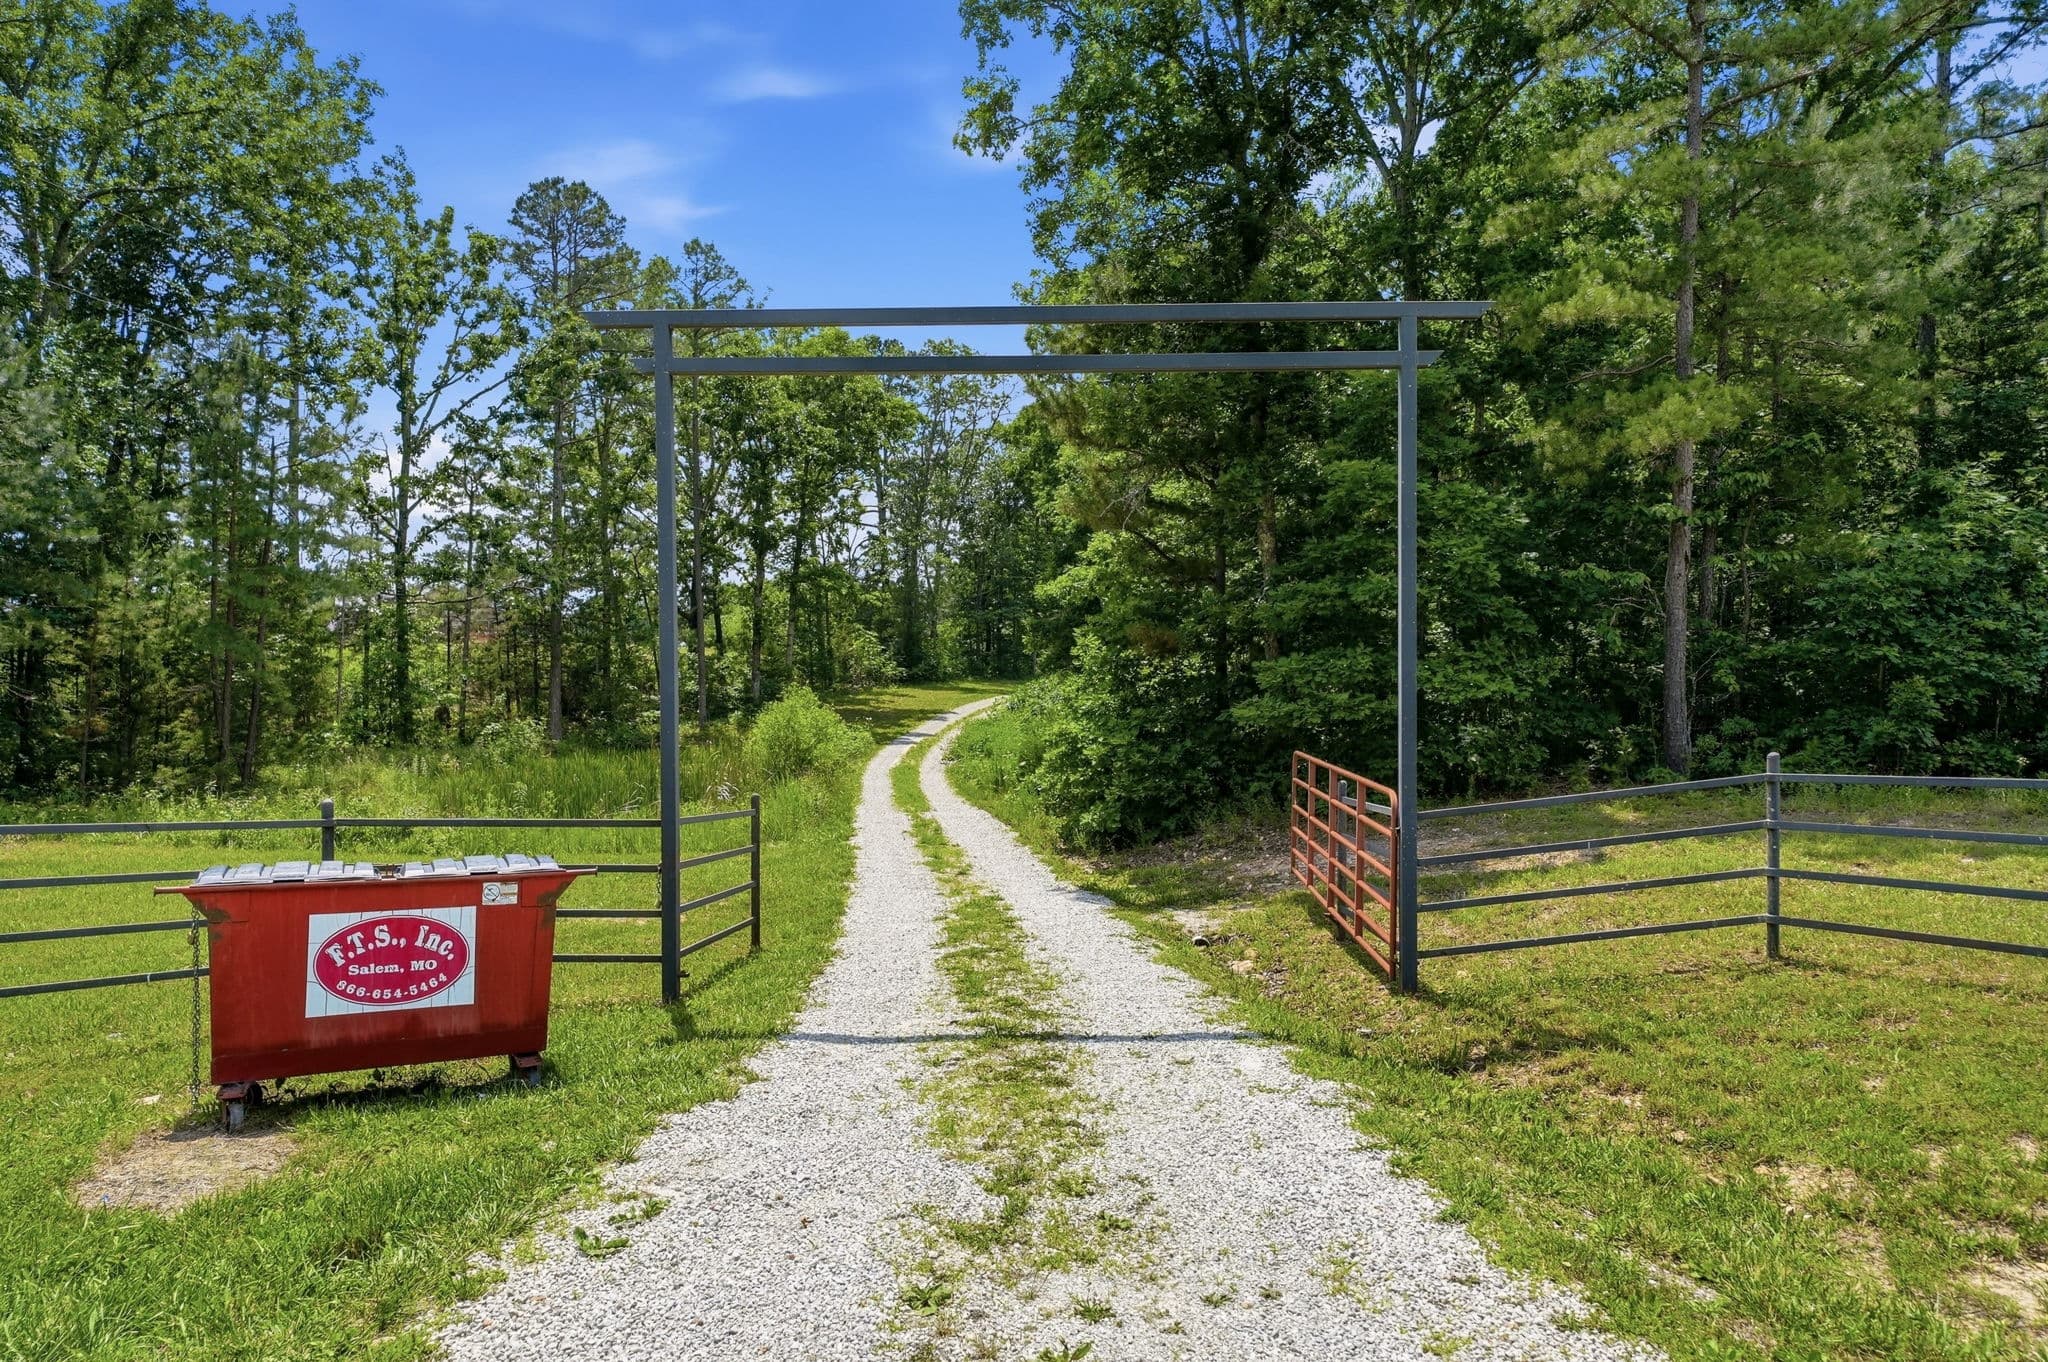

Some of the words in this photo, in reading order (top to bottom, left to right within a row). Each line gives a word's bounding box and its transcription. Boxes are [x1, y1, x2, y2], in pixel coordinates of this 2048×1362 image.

[325, 924, 407, 967] F.T.S.,
[414, 925, 455, 961] Inc.
[348, 963, 405, 976] Salem,
[410, 959, 438, 971] MO
[336, 972, 448, 999] 866-654-5464
